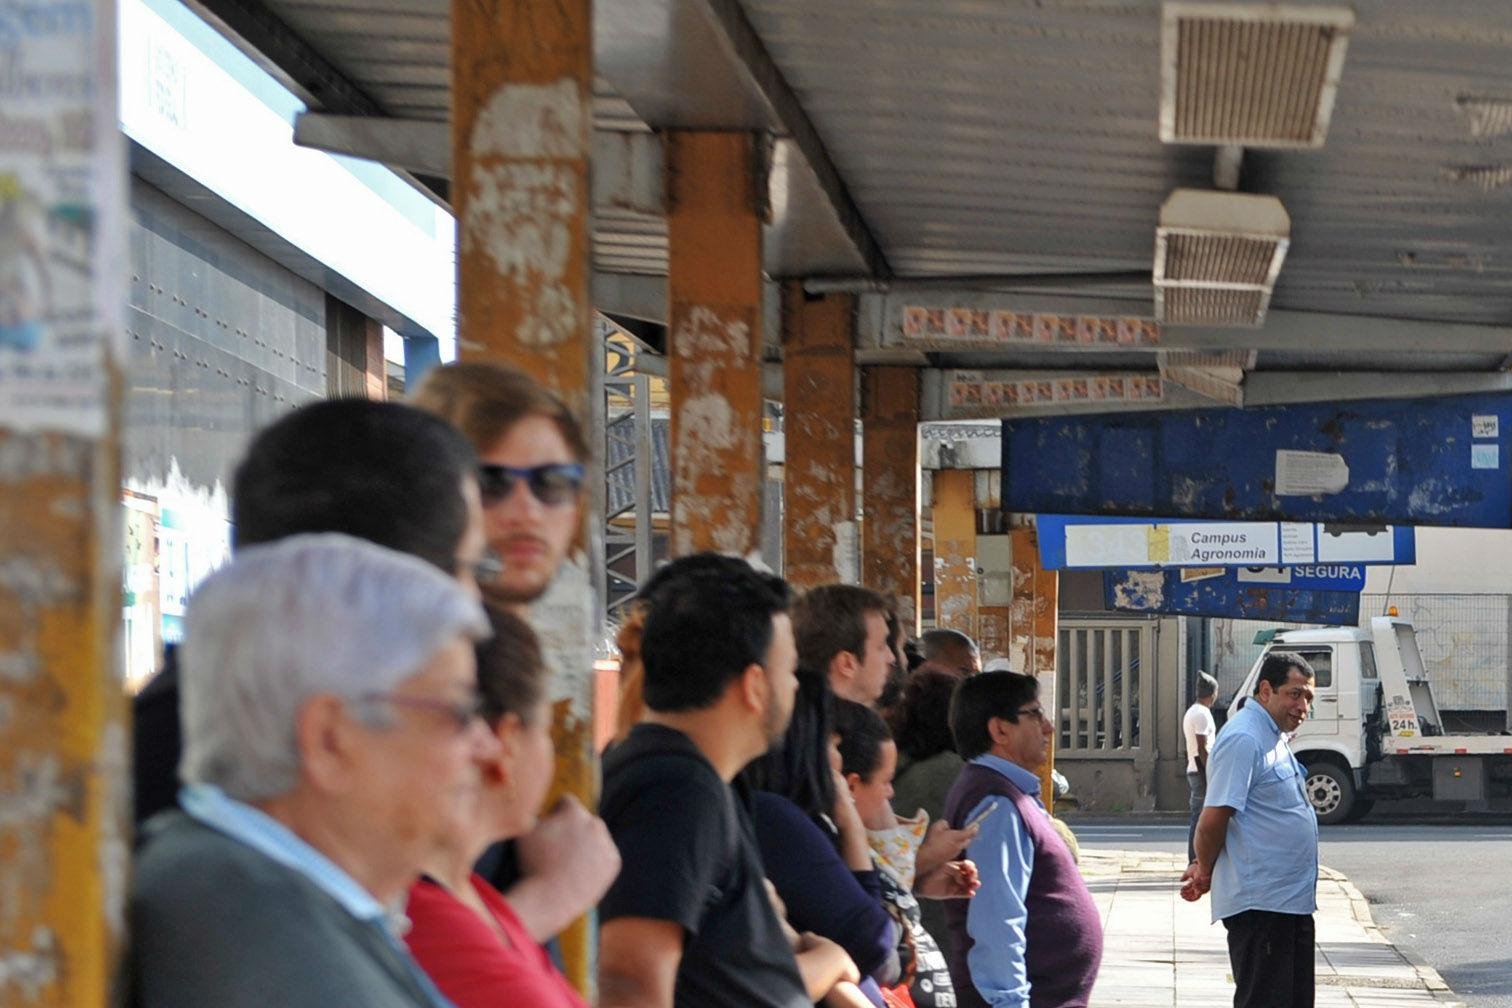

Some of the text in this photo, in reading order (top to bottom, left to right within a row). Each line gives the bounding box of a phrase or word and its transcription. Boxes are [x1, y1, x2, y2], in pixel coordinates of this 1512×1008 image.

[1190, 532, 1247, 546] Campus
[1190, 547, 1267, 562] Agronomia
[1294, 565, 1361, 580] SEGURA
